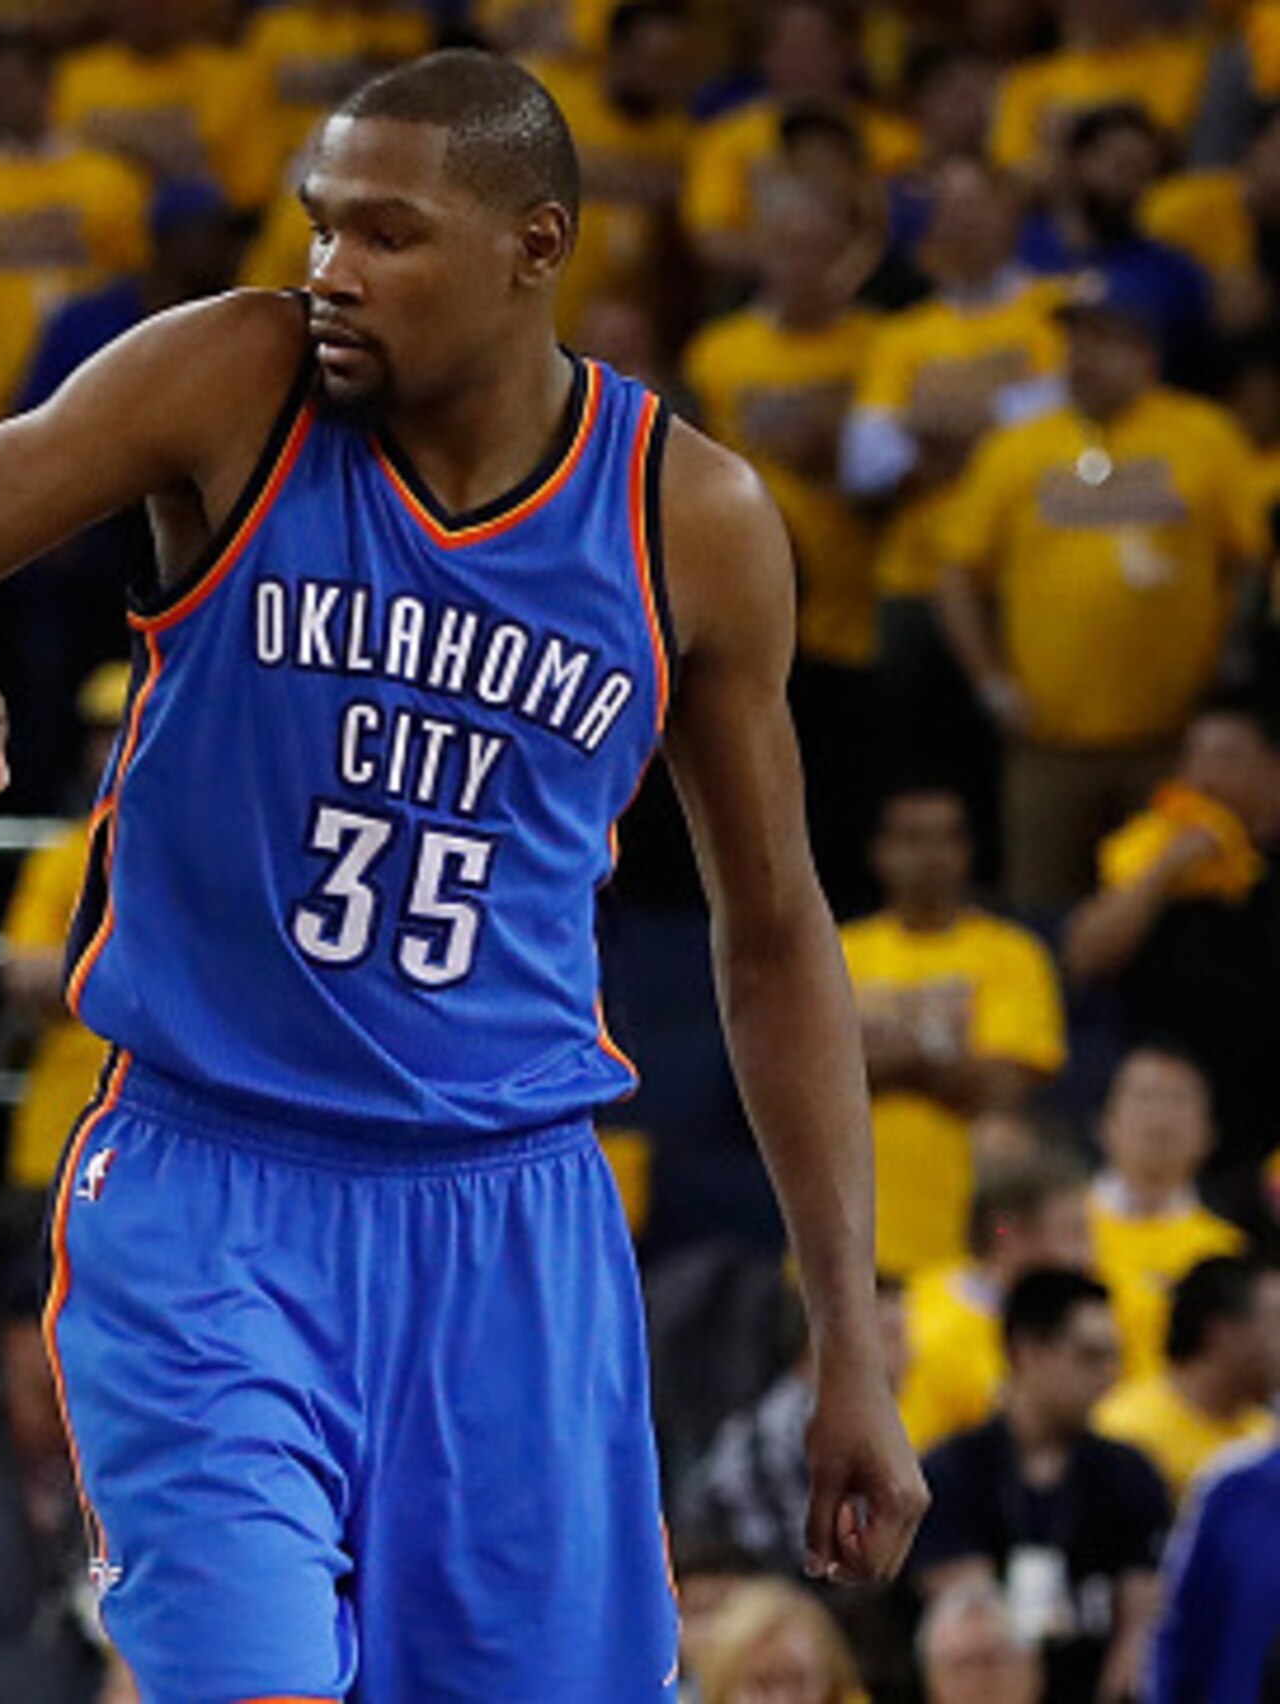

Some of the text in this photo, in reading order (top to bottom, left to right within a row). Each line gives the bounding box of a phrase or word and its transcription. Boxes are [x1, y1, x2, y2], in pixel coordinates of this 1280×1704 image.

[256, 580, 633, 751] OKLAHOMA
[341, 703, 503, 813] CITY
[293, 806, 493, 986] 35
